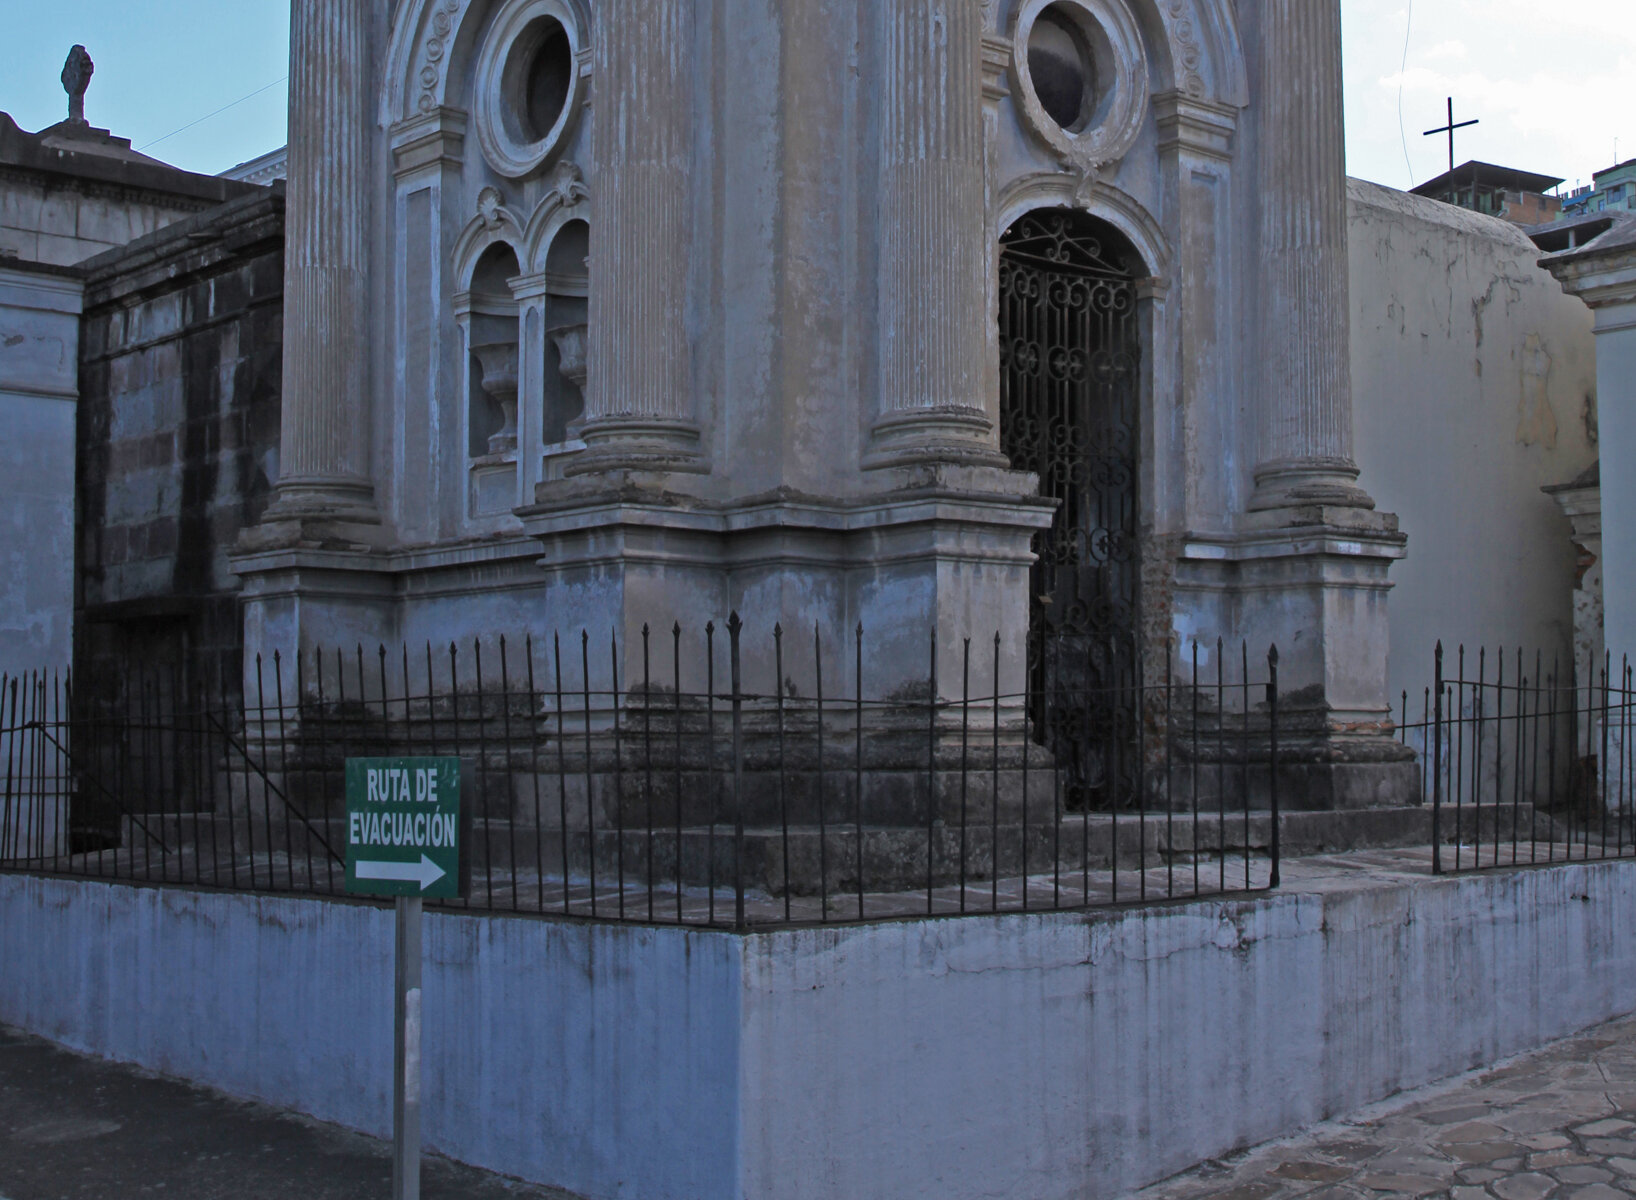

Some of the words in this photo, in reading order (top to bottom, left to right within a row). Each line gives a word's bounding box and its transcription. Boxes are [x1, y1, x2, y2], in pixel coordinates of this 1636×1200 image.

[367, 768, 411, 802] RUTA
[415, 768, 438, 802] DE
[349, 805, 455, 847] EVACUACIÓN
